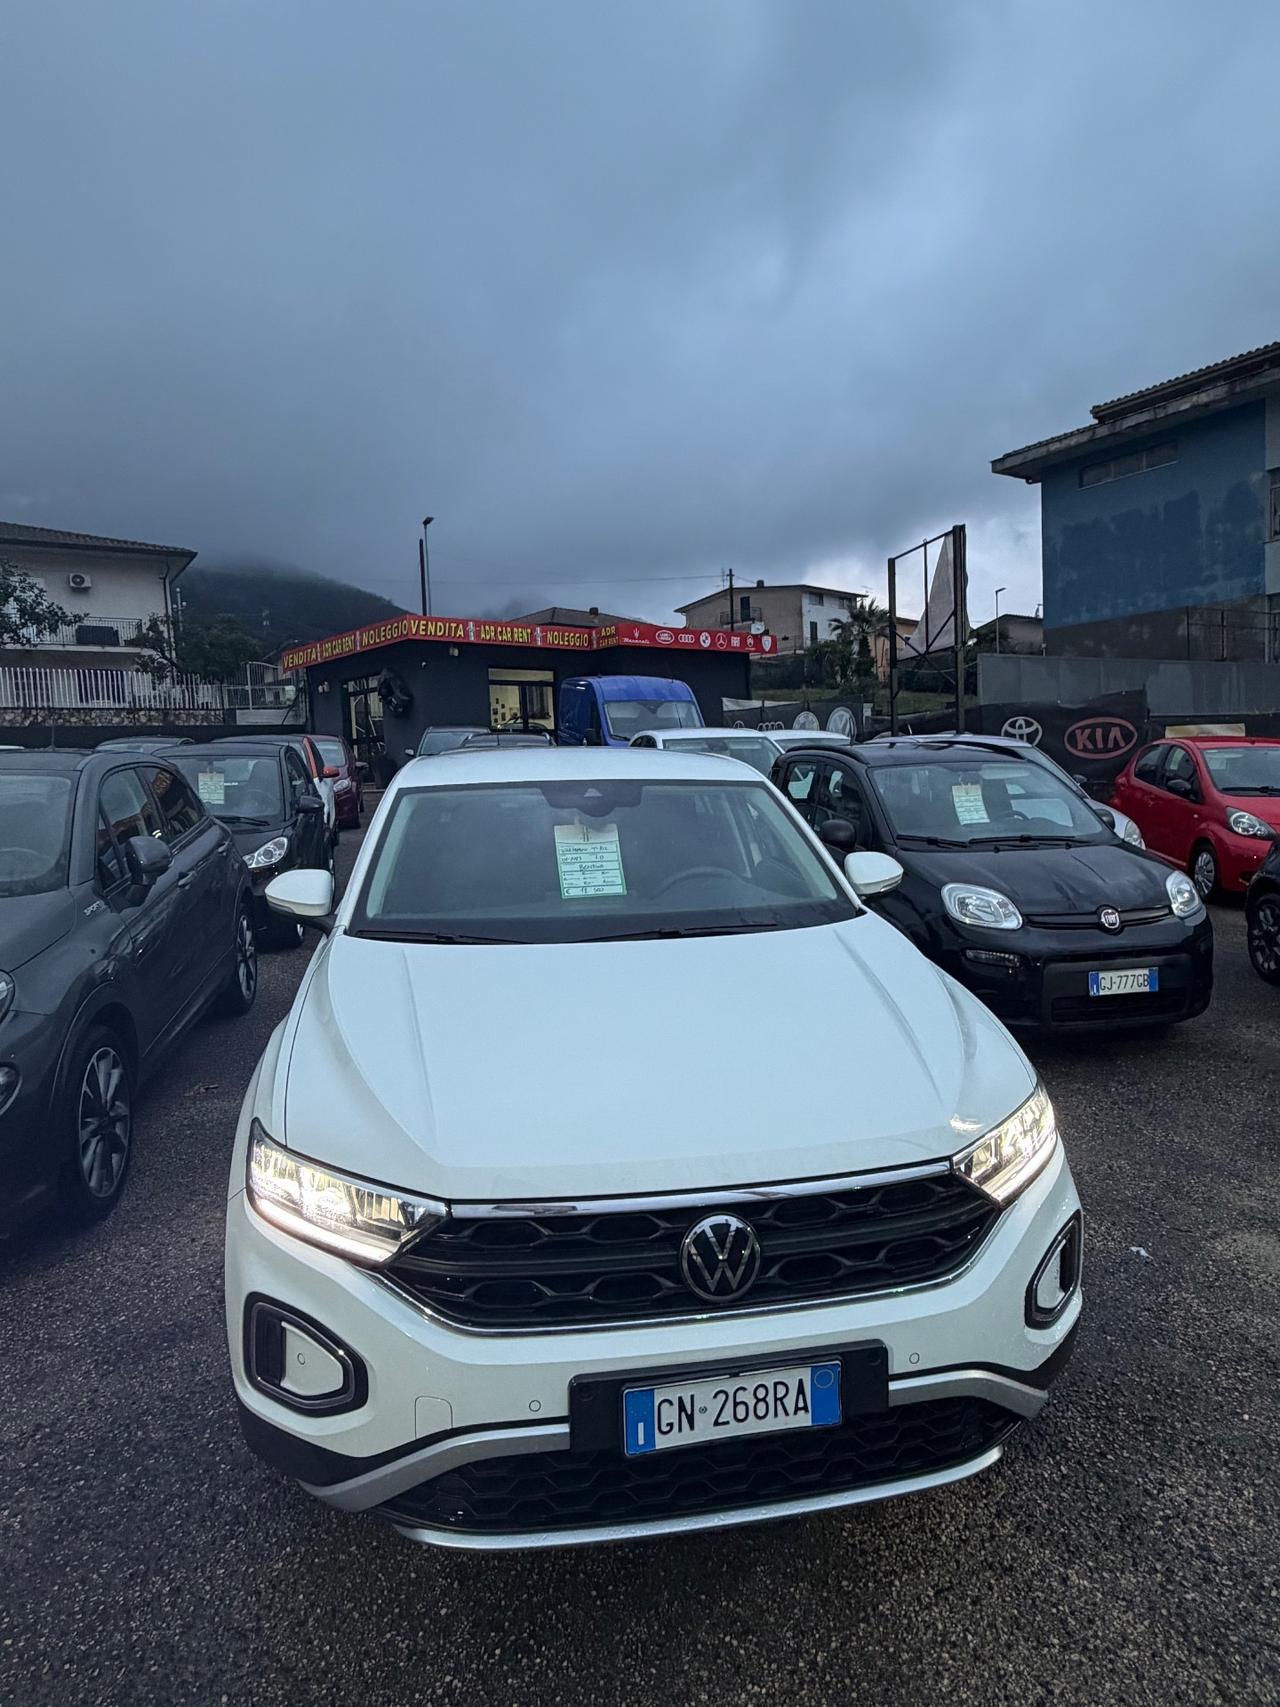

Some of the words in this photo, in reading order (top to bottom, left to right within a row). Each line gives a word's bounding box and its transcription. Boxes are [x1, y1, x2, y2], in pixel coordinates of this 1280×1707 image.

[410, 620, 464, 638] VENDITA
[480, 626, 496, 640] ADR
[497, 626, 512, 641] CAR
[513, 628, 532, 643] RENT
[546, 631, 589, 647] NOLEGGIO
[600, 625, 616, 637] ADR
[283, 647, 316, 669] VENDITA
[362, 620, 409, 647] NOLEGGIO
[1075, 727, 1126, 750] KIA
